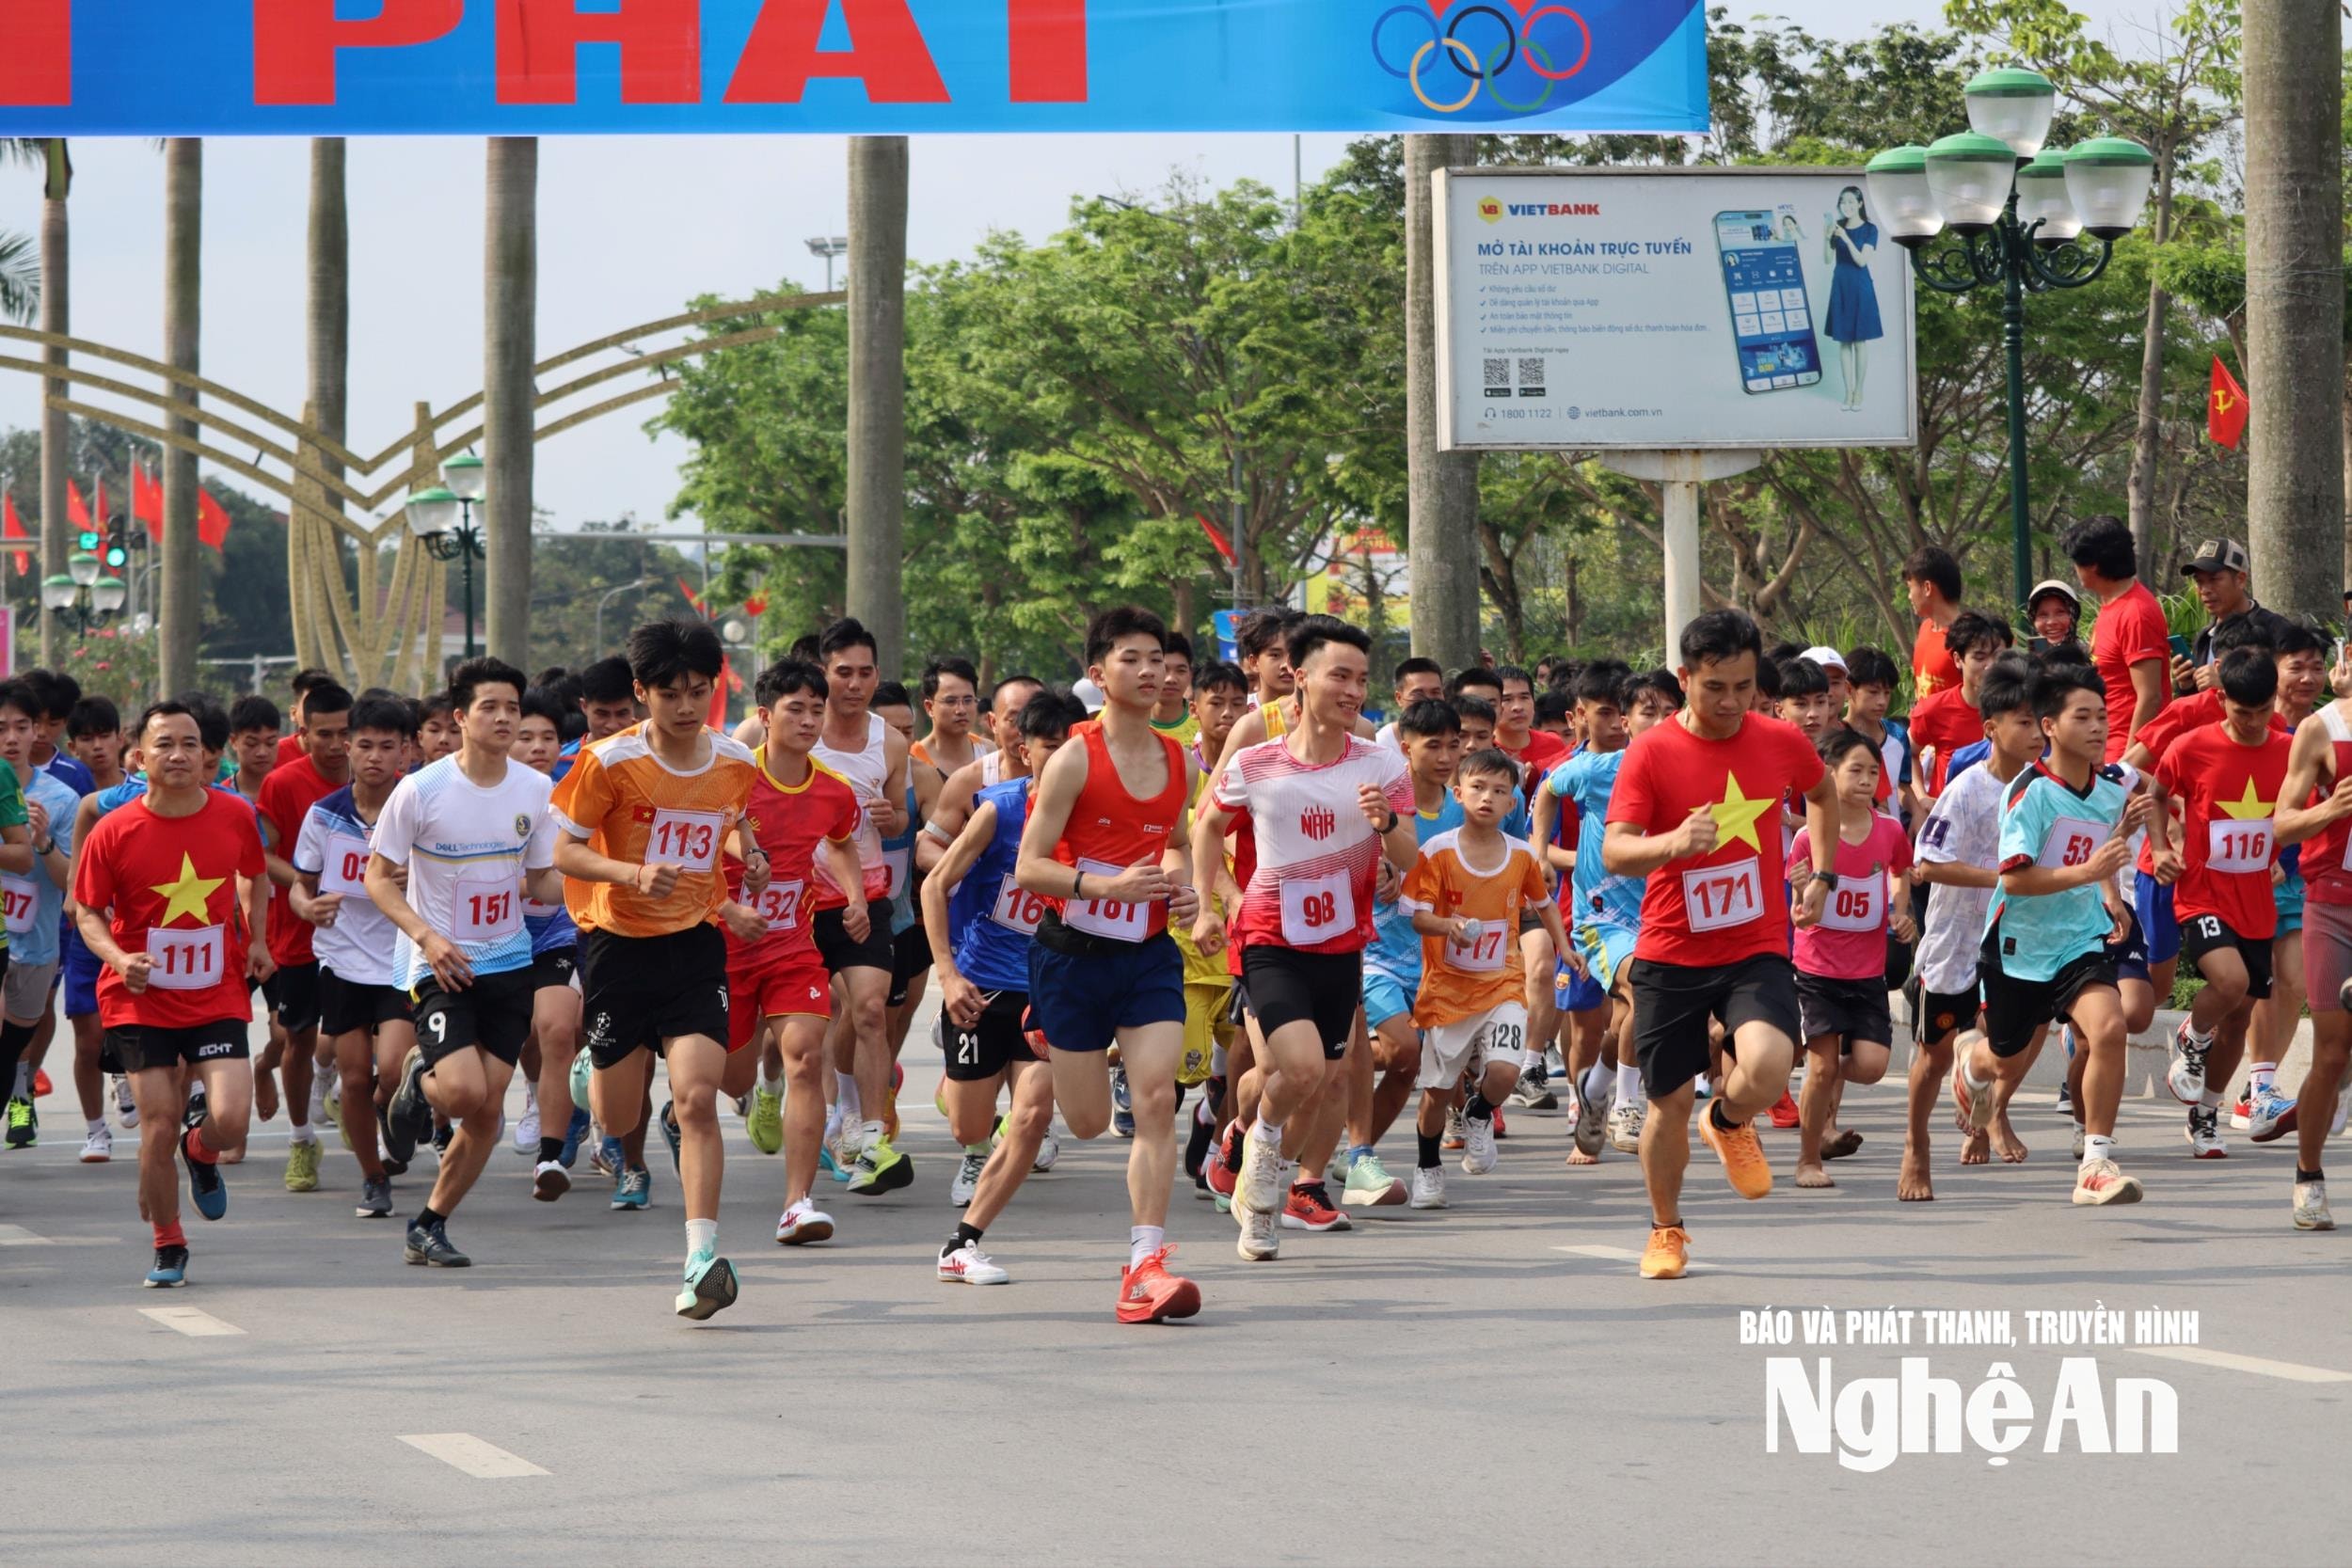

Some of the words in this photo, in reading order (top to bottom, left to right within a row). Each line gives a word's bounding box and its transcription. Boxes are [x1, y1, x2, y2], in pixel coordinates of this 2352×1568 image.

[1507, 204, 1600, 216] VIETBANK
[1477, 238, 1504, 256] MỞ
[1509, 240, 1533, 256] TÀI
[1538, 238, 1596, 256] KHOẢN
[1599, 241, 1640, 259] TRỰC
[1645, 237, 1692, 255] TUYẾN
[1479, 261, 1509, 276] TRÊN
[1513, 263, 1537, 275] APP
[1541, 263, 1599, 275] VIETBANK
[1603, 262, 1648, 275] DIGITAL
[1502, 409, 1525, 419] 1800
[1529, 408, 1551, 419] 1122
[1584, 406, 1662, 418] vietbank.com.vn
[658, 820, 713, 860] 113
[2062, 834, 2093, 866] 53
[2222, 832, 2265, 860] 116
[468, 890, 511, 926] 151
[746, 889, 796, 922] 132
[1303, 891, 1336, 927] 98
[1692, 872, 1753, 918] 171
[1836, 890, 1869, 918] 05
[2197, 915, 2221, 939] 13
[162, 942, 212, 974] 111
[1455, 931, 1502, 959] 17
[428, 1011, 446, 1043] 9
[1491, 1022, 1521, 1051] 128
[199, 1042, 233, 1056] ECHT
[958, 1033, 978, 1064] 21
